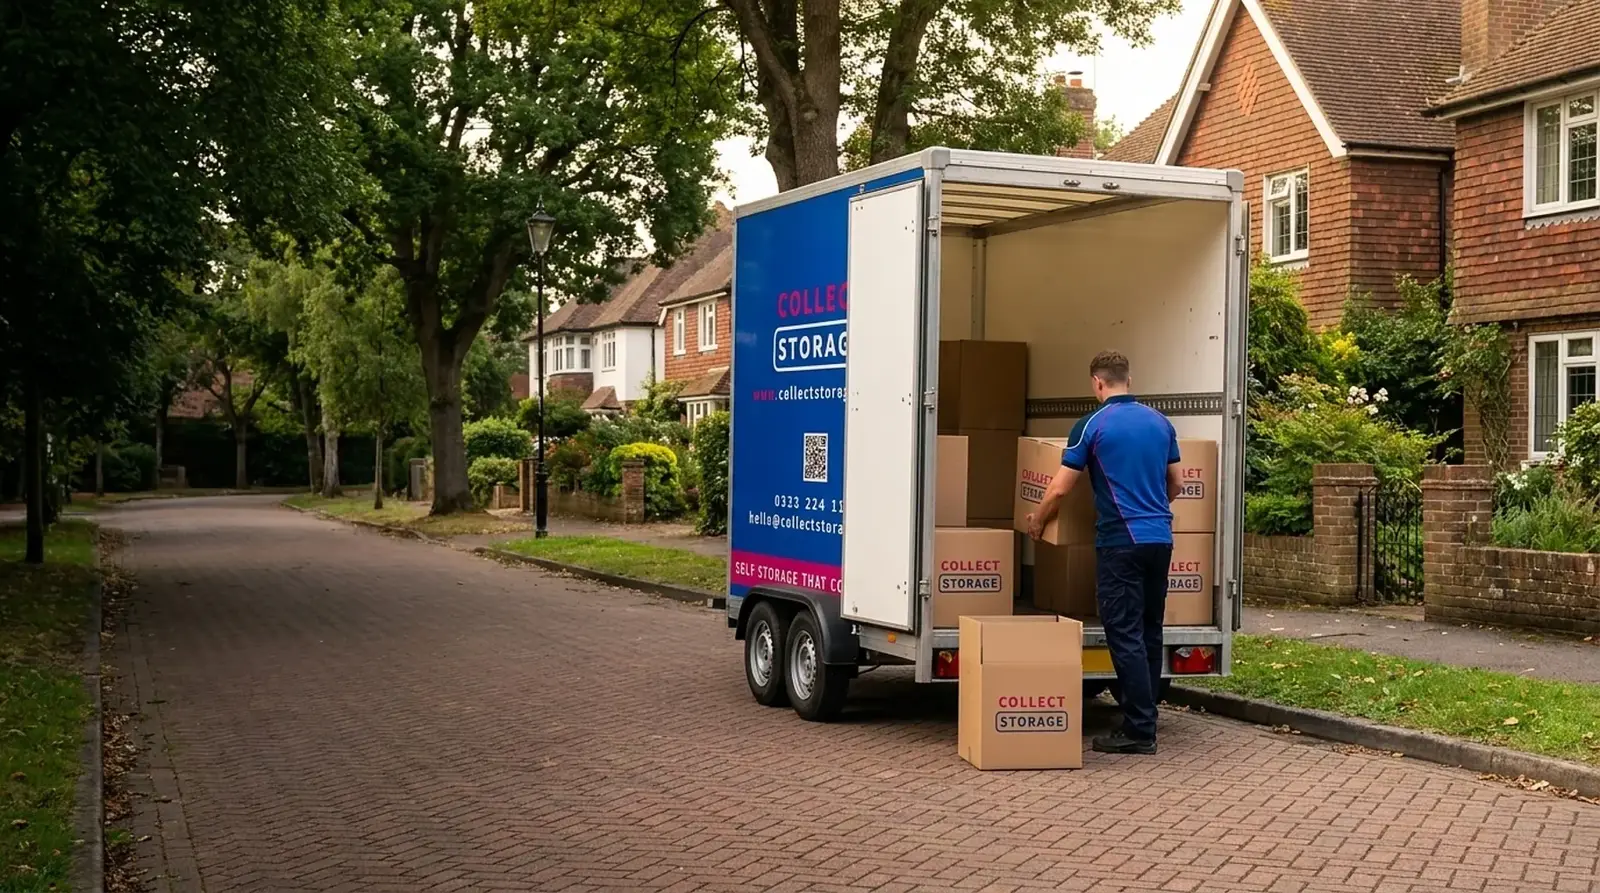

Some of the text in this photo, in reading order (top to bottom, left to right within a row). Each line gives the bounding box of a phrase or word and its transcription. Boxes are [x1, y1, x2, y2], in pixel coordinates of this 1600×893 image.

[774, 494, 800, 509] 0333
[805, 497, 825, 511] 224
[941, 560, 1000, 571] COLLECT
[735, 561, 756, 577] SELF
[757, 565, 799, 585] STORAGE
[801, 572, 827, 591] THAT
[942, 578, 998, 589] STORAGE
[998, 696, 1066, 708] COLLECT
[1000, 716, 1063, 727] STORAGE
